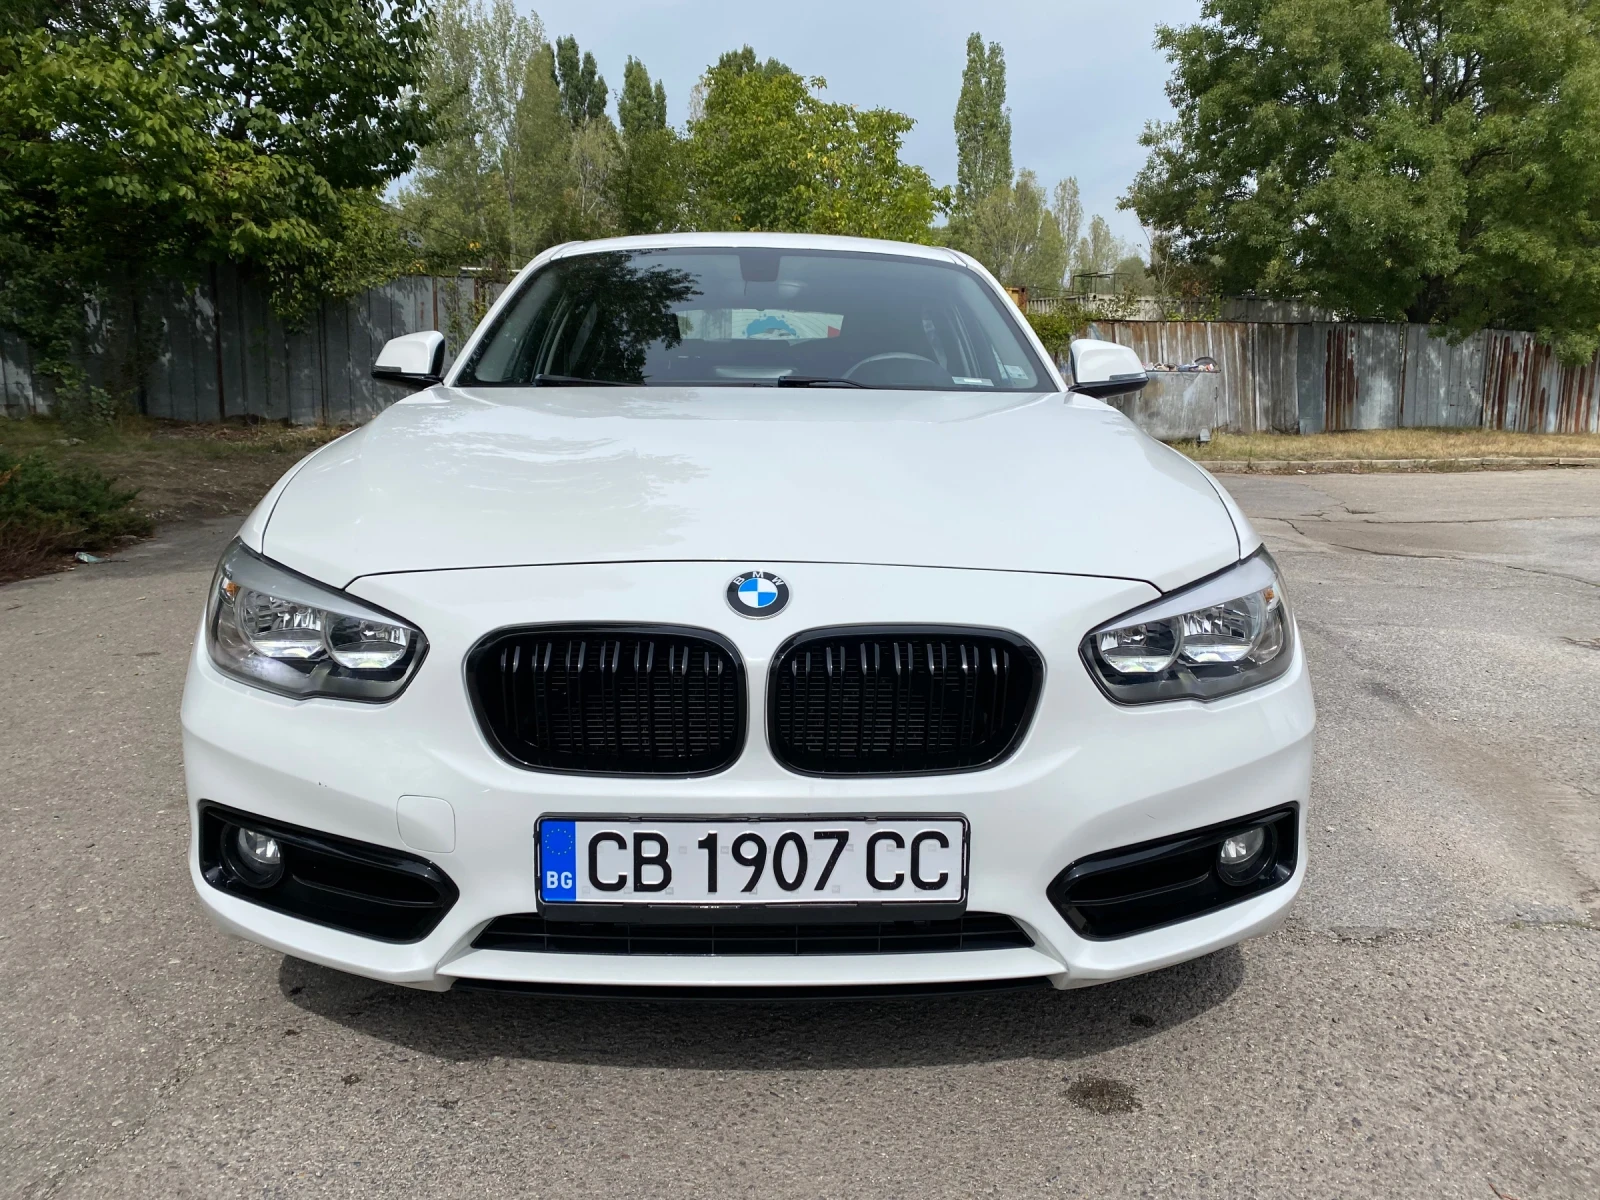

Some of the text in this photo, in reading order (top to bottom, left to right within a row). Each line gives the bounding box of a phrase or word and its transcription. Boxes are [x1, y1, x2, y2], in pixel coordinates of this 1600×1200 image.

[732, 571, 784, 586] BMW
[588, 830, 949, 893] CB 1907 CC
[546, 871, 573, 889] BG
